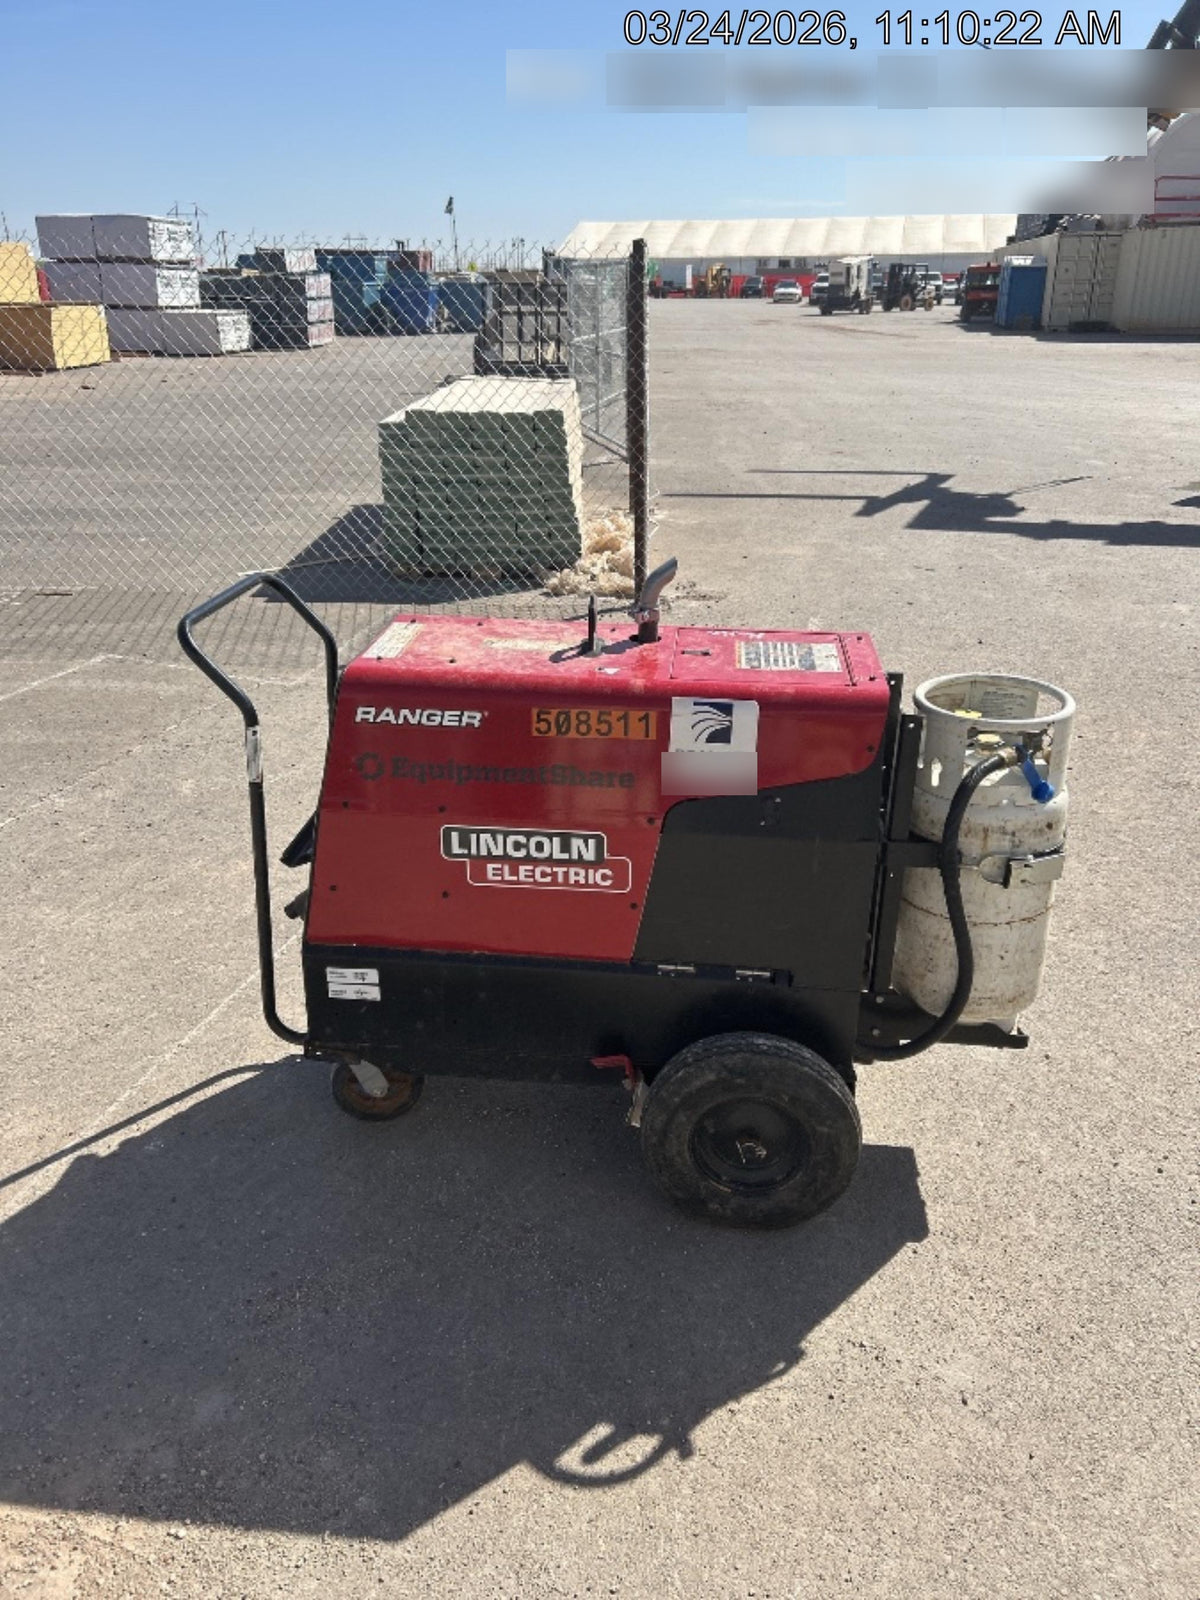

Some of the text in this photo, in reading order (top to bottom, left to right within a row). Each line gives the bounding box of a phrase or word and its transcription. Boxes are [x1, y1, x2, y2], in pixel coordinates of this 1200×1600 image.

[355, 706, 482, 728] RANGER
[534, 709, 651, 738] 508511
[391, 756, 636, 789] EquipmentShare
[450, 831, 597, 862] LINCOLN
[486, 863, 614, 887] ELECTRIC
